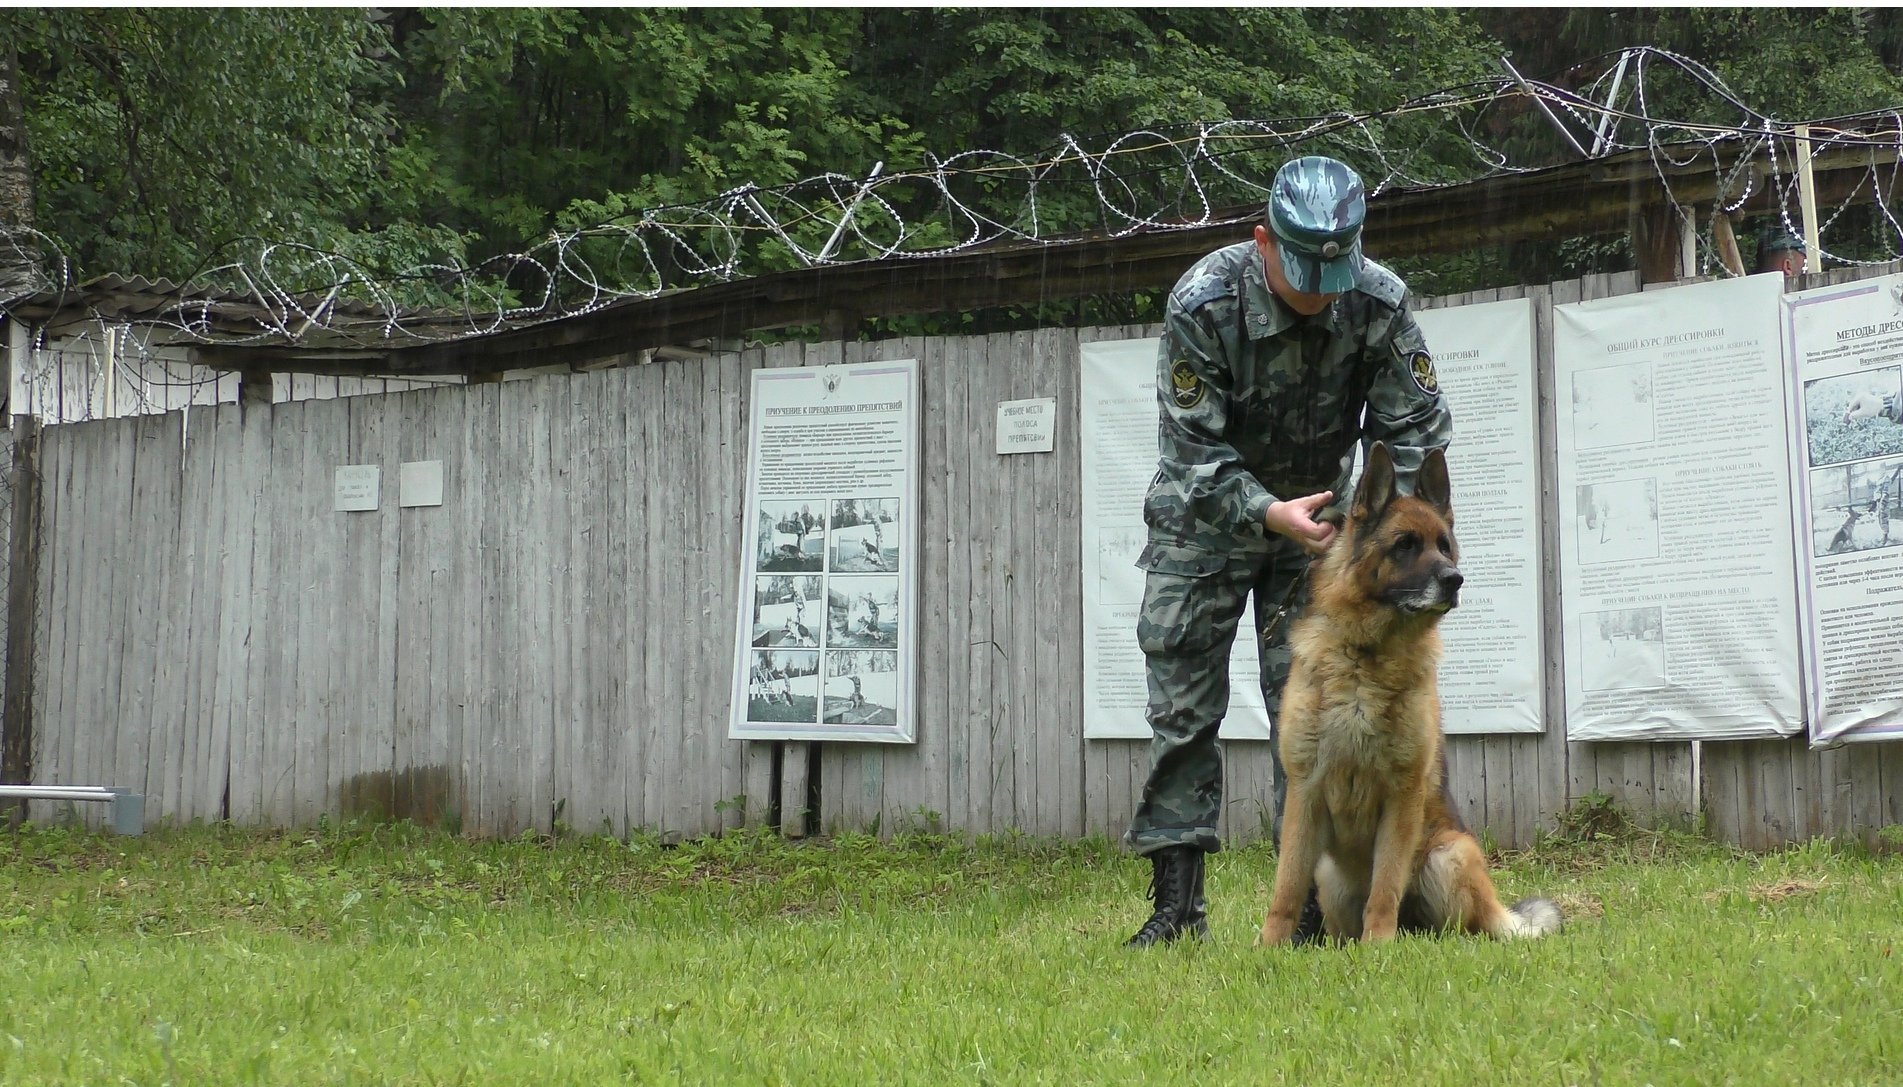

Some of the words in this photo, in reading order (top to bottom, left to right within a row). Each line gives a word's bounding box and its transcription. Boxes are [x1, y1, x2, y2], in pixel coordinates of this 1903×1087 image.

[1837, 325, 1876, 340] МЕТОДЫ
[1607, 339, 1638, 353] ОБЩИЙ
[1640, 337, 1662, 348] КУРС
[1664, 328, 1724, 346] ДРЕССИРОВКИ
[1431, 349, 1479, 361] ЕССИРОВКИ
[766, 407, 801, 416] ПРИУЧЕНИЕ
[803, 406, 808, 414] К
[809, 404, 855, 415] ПРЕОДОЛЕНИЮ
[857, 400, 903, 412] ПРЕПЯТСТВИЙ
[1014, 420, 1038, 428] ПОЛОСА
